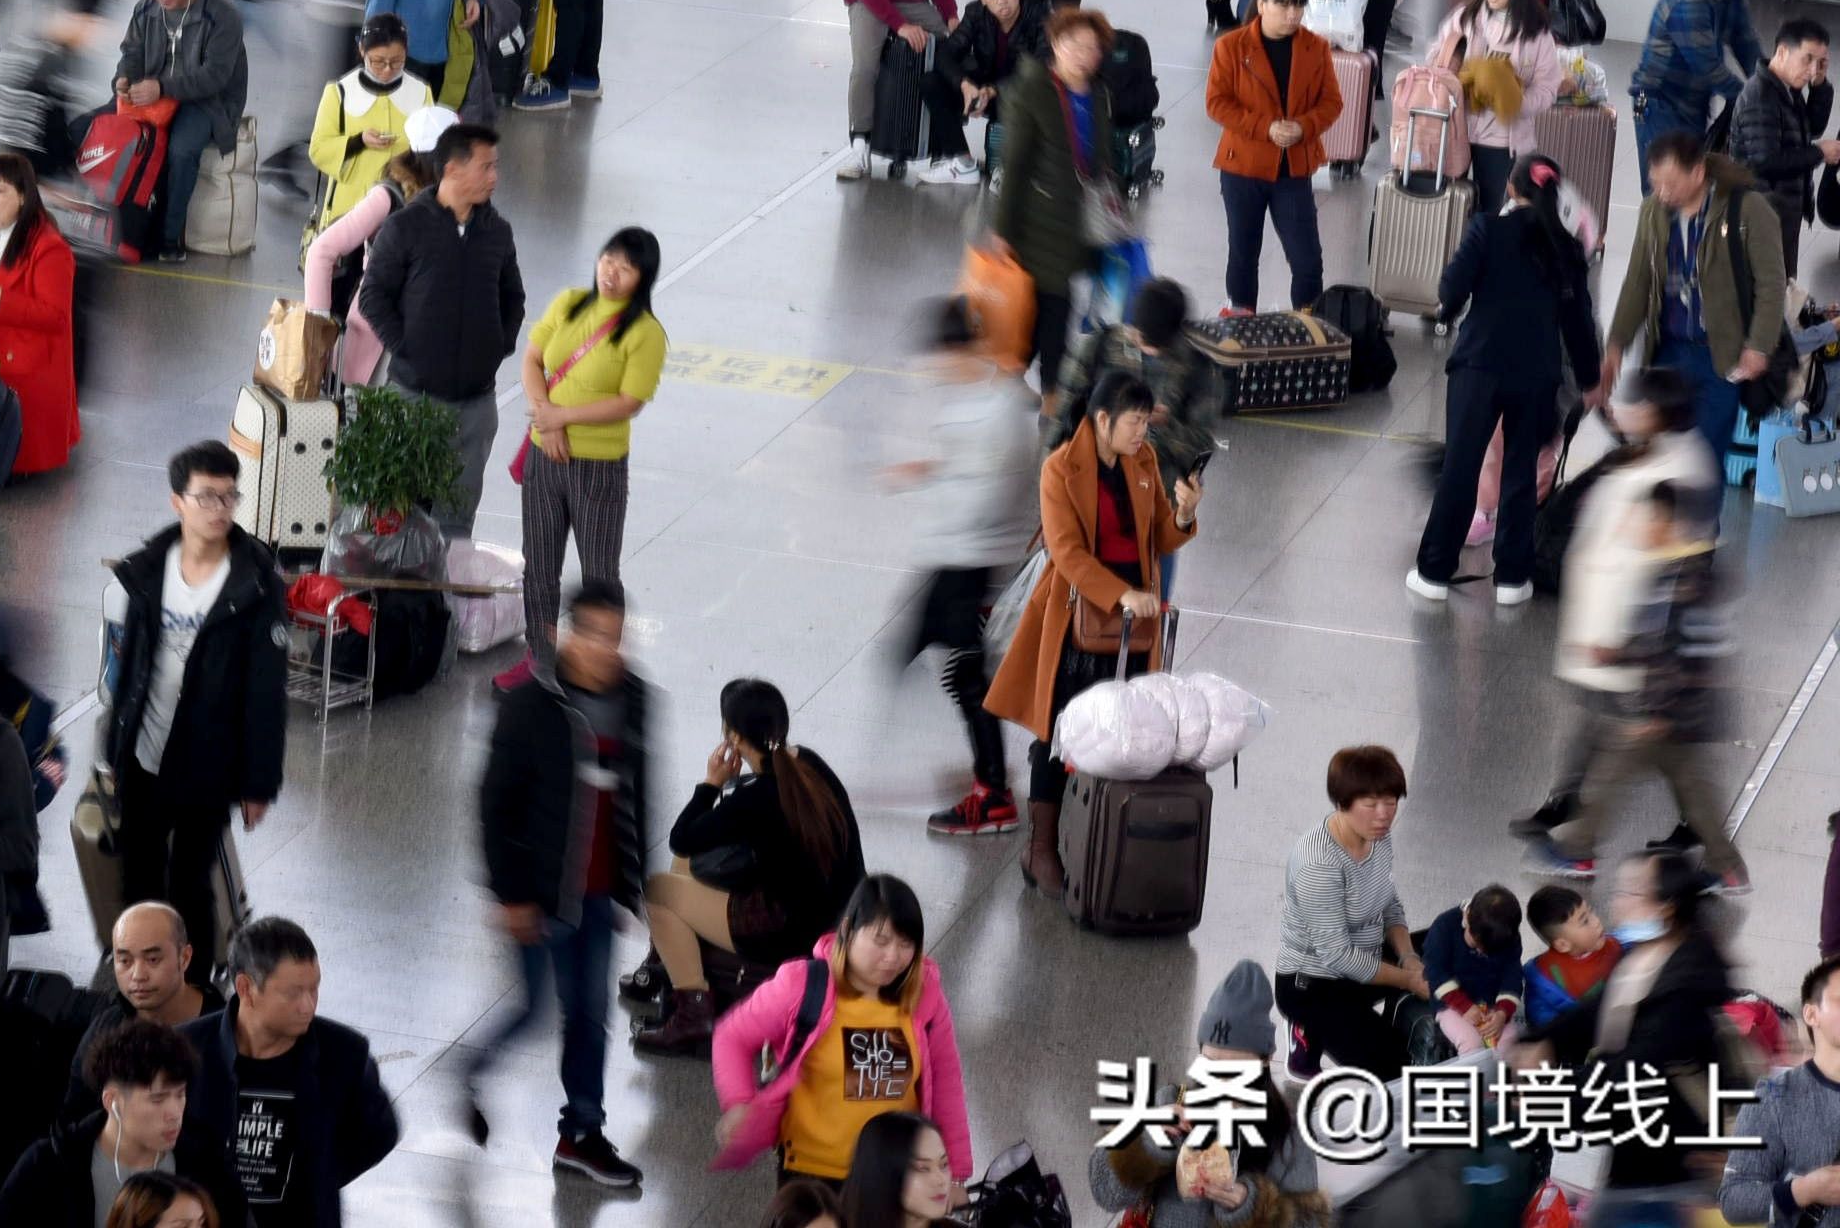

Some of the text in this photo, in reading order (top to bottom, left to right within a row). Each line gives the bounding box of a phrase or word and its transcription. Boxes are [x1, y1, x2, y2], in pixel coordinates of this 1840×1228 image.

[80, 146, 105, 160] NIKE
[239, 1119, 283, 1139] IMPLE
[243, 1138, 274, 1157] LIFE
